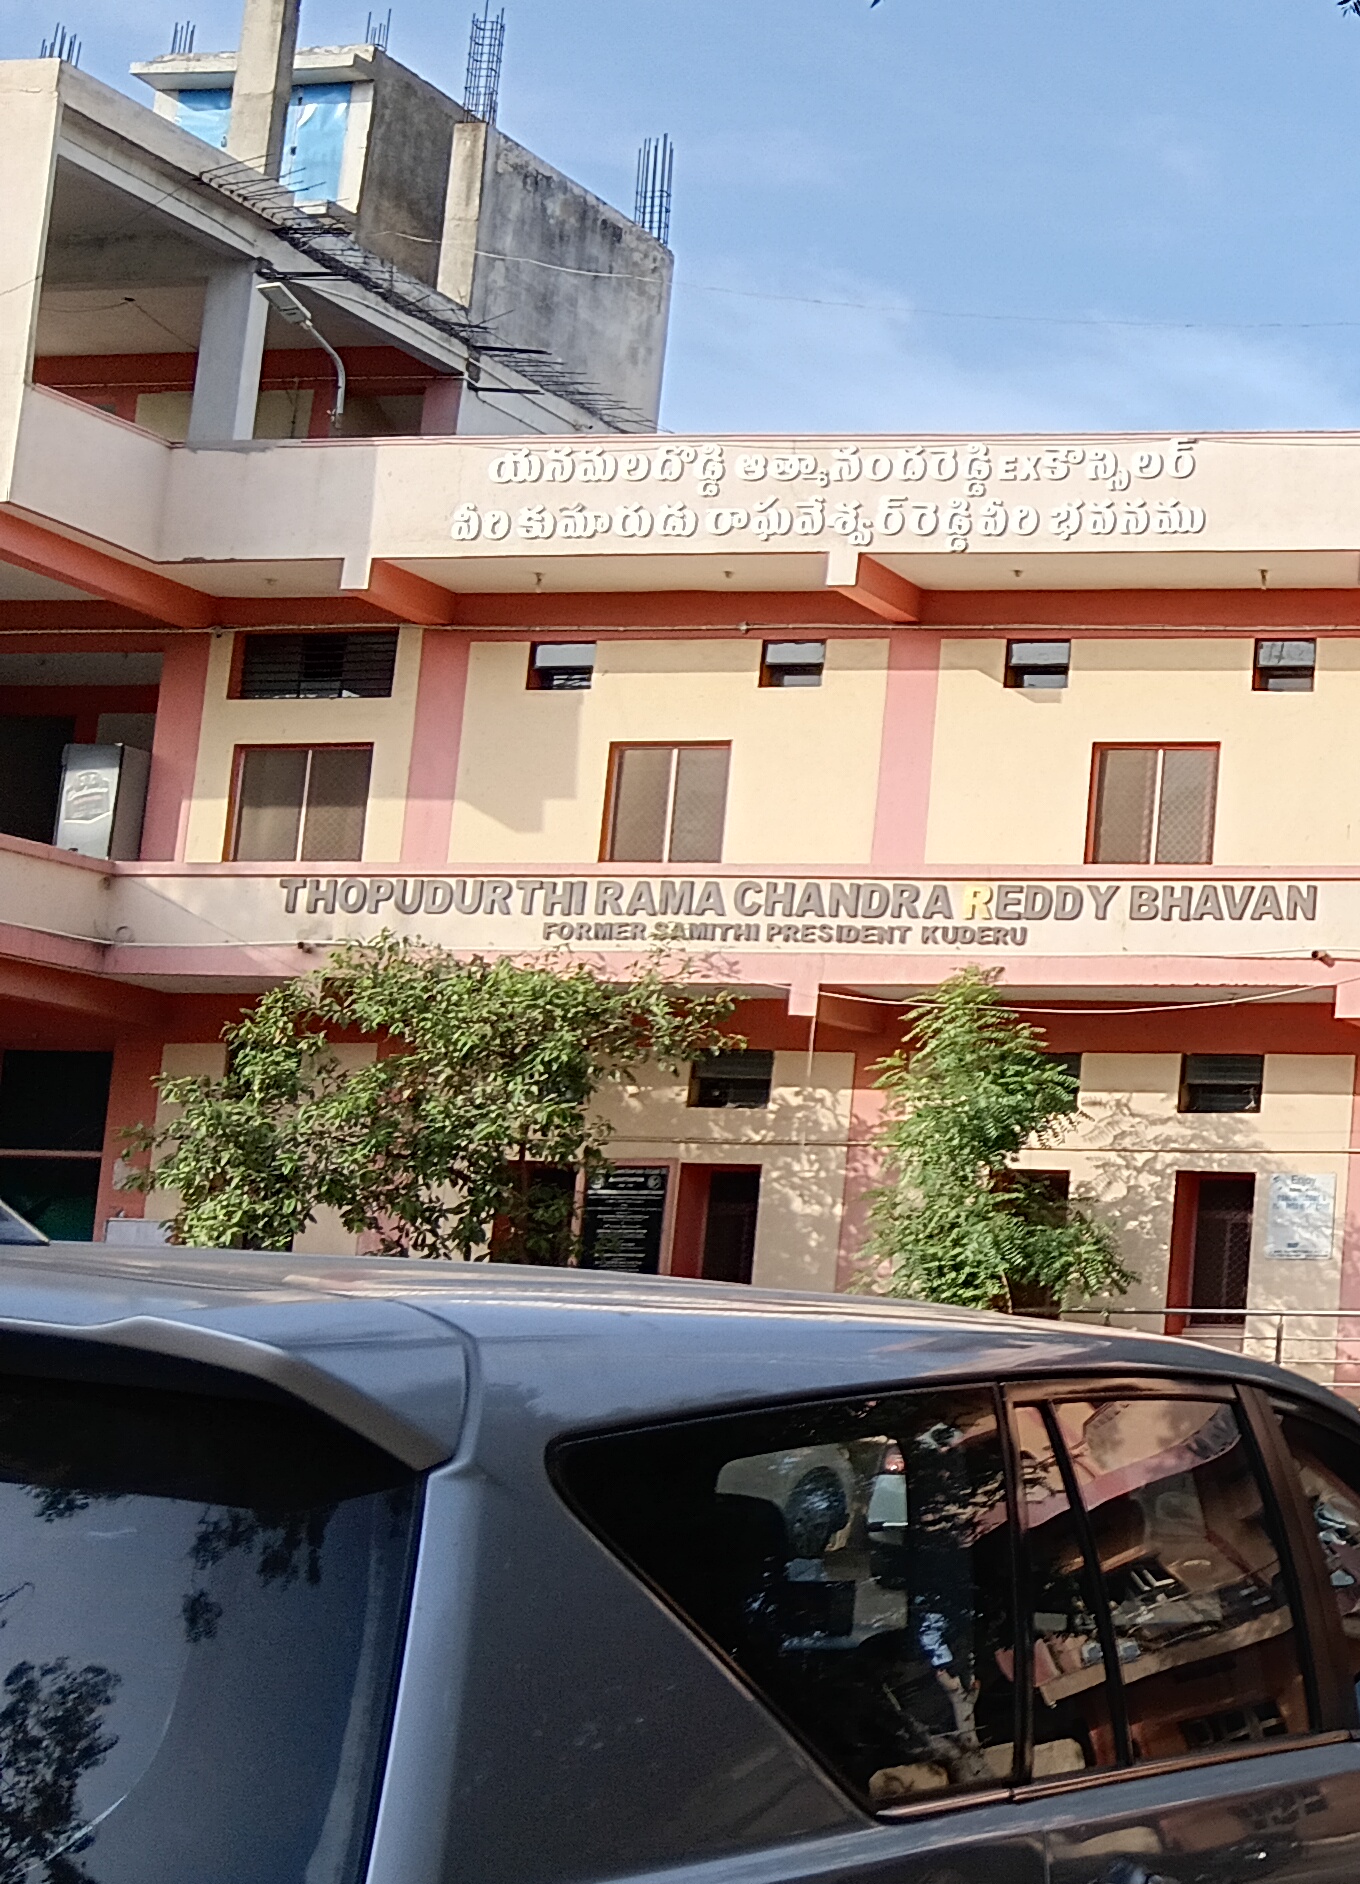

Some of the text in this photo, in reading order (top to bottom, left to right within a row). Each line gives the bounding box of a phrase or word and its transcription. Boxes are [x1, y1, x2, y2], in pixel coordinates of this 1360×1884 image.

[1049, 497, 1206, 540] భవనము
[279, 878, 1319, 922] THOPUDURTHI RAMA CHANDRA REDDY BHAVAN
[543, 922, 647, 941] FORMER
[767, 923, 913, 945] PRESIDENT
[921, 926, 1028, 947] KUDERU
